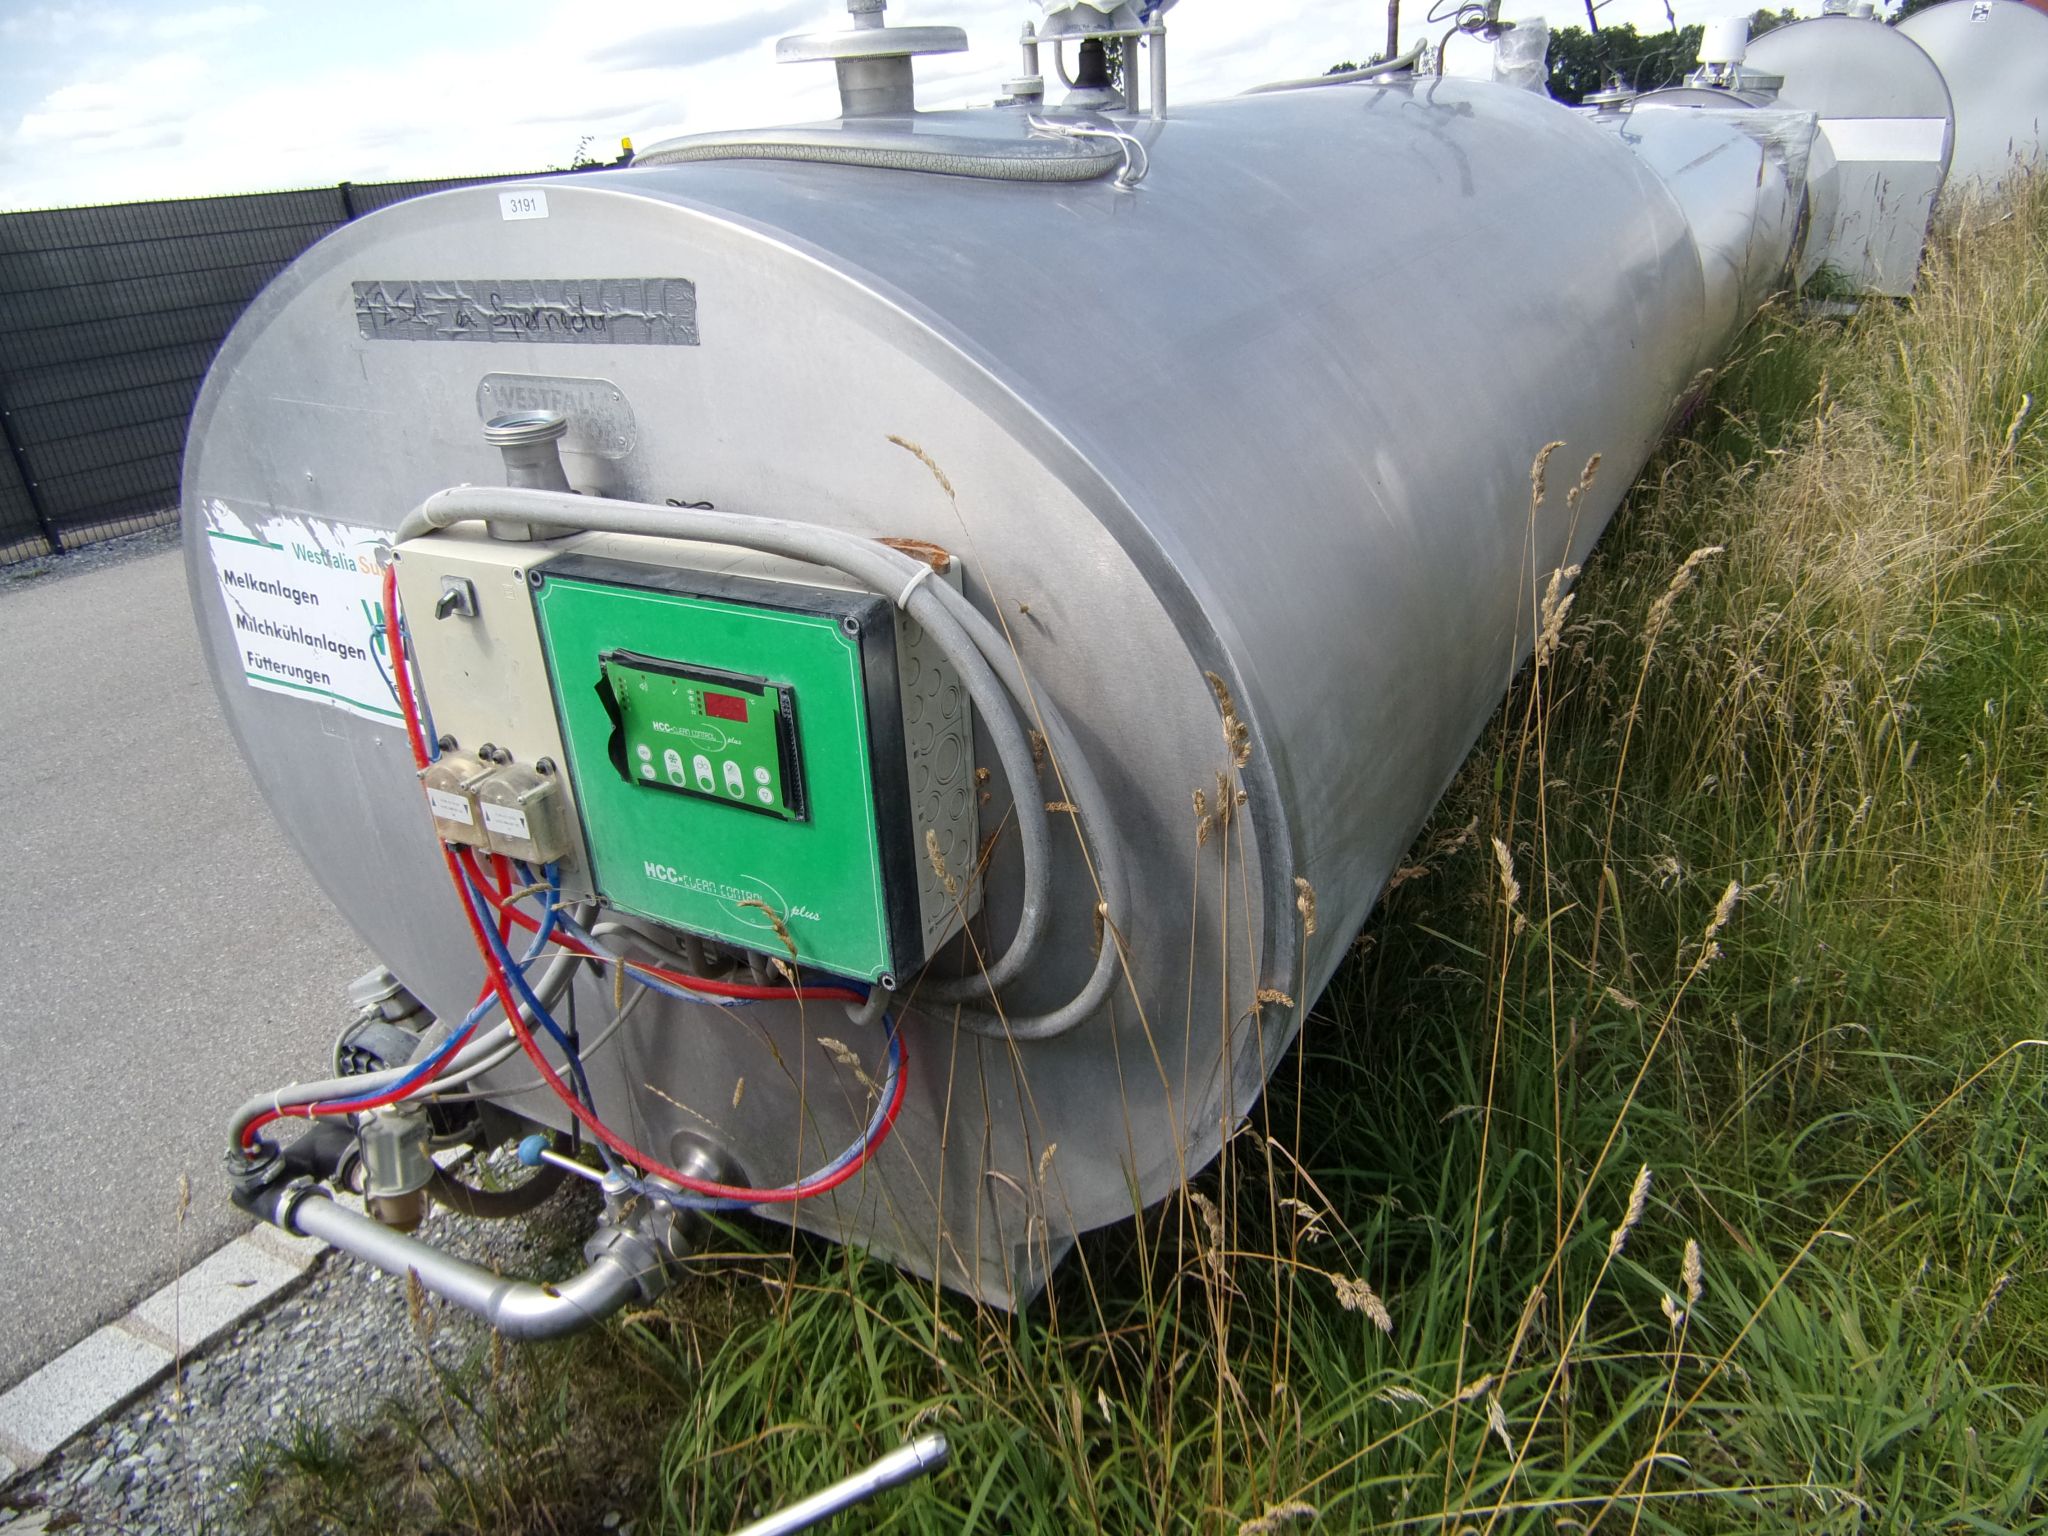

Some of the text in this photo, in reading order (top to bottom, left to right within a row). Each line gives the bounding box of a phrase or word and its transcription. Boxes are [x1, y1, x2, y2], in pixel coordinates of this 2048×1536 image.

[511, 198, 536, 213] 3191
[292, 542, 357, 572] Westfalia
[224, 569, 319, 606] Melkanlagen
[236, 613, 367, 661] Milchkühlanlagen
[247, 651, 331, 685] Fütterungen
[791, 905, 821, 921] plus
